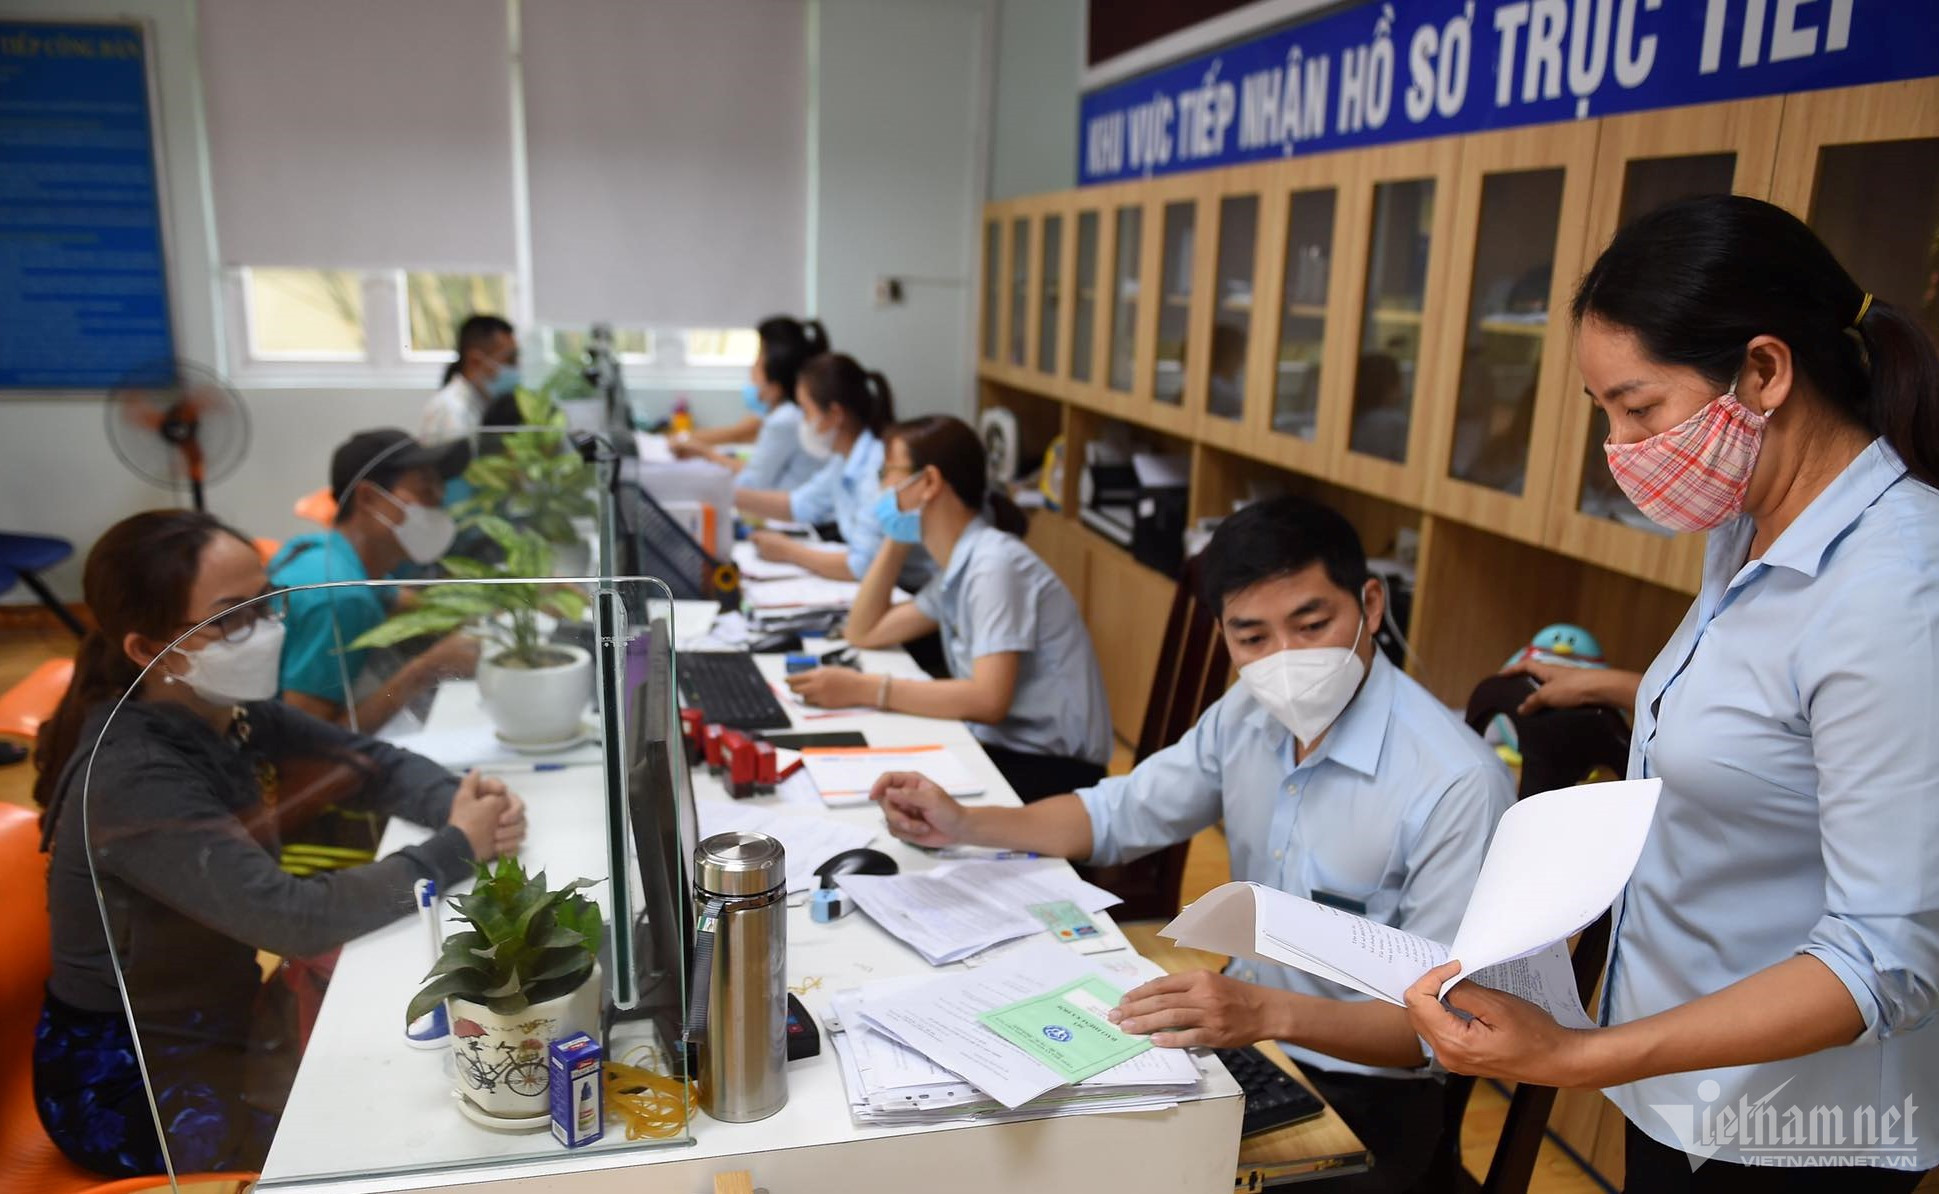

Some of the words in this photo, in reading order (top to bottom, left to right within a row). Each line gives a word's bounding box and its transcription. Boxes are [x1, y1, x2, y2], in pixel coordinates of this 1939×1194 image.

[1086, 108, 1126, 178] KHU
[1128, 90, 1174, 181] VỰC
[1177, 56, 1236, 162] TIẾP
[1238, 44, 1330, 157] NHẬN
[1336, 2, 1395, 135] HỒ
[1405, 0, 1476, 123] SƠ
